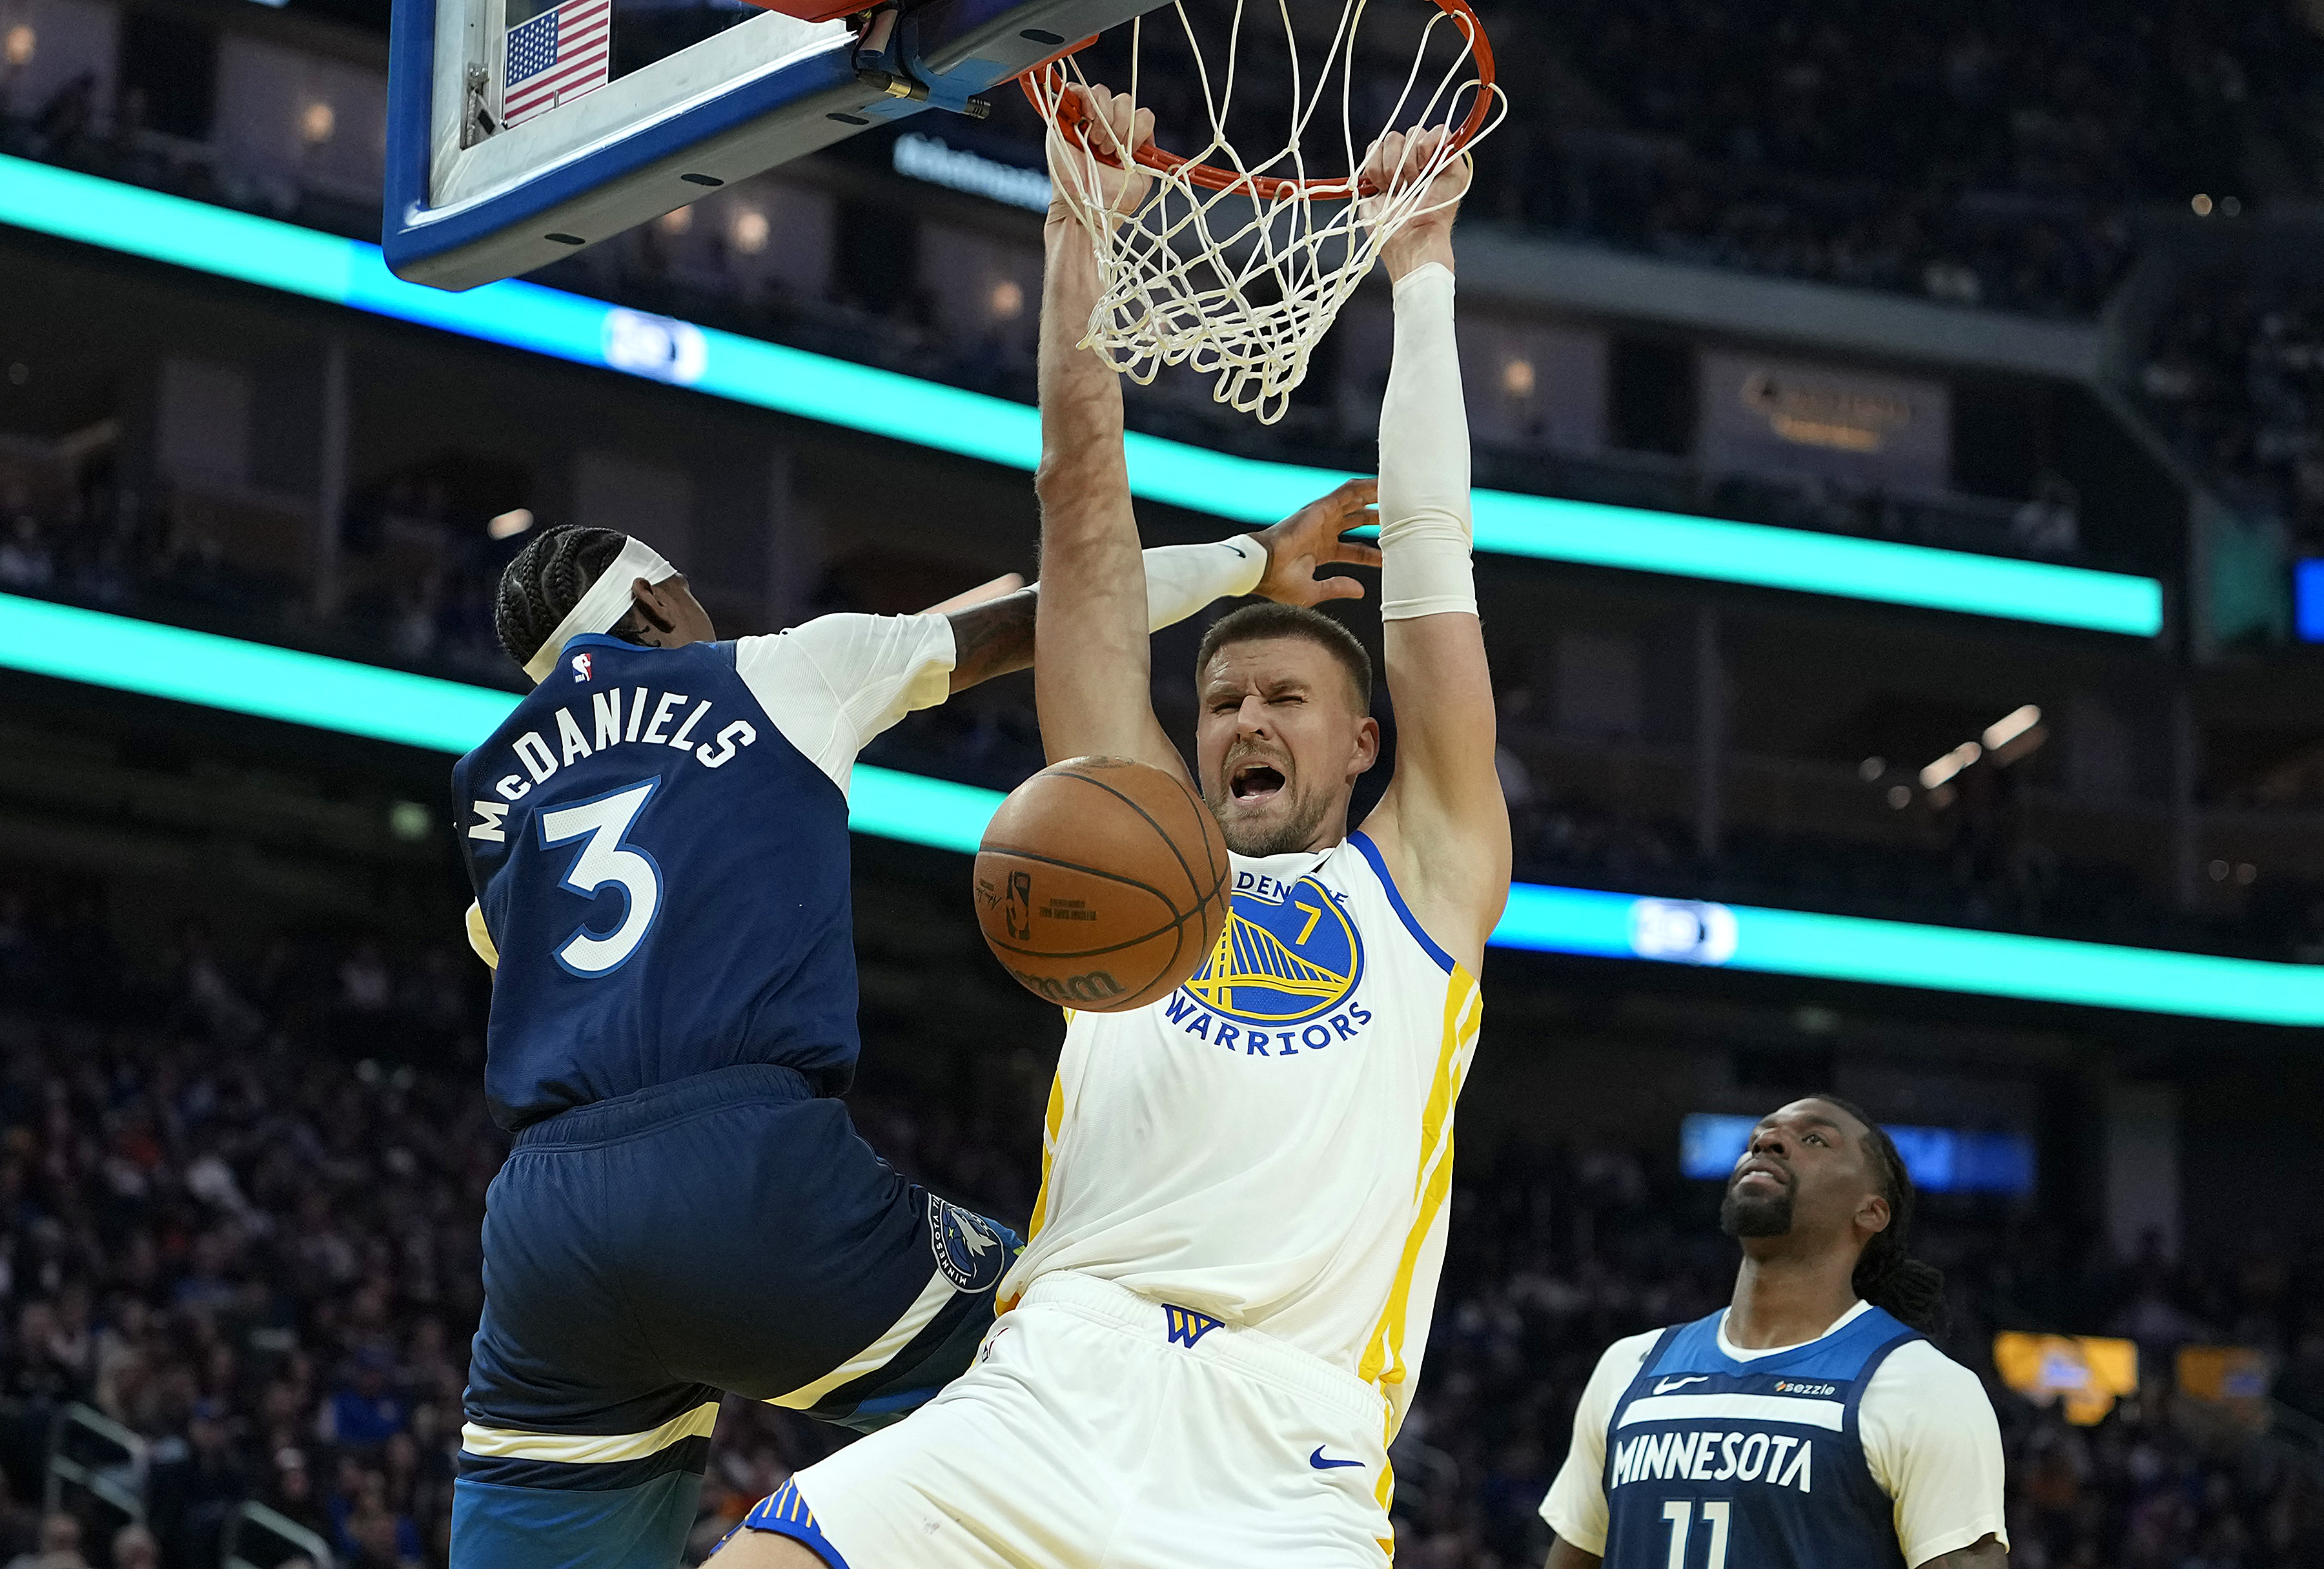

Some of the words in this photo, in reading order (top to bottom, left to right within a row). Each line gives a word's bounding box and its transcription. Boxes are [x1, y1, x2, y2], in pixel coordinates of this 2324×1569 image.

[535, 775, 664, 979] 3
[1236, 871, 1291, 899] DEN
[1294, 900, 1322, 945] 7
[1165, 989, 1372, 1057] WARRIORS
[932, 1215, 970, 1287] MINNESOTA
[1784, 1382, 1836, 1396] sezzle
[1611, 1431, 1812, 1493] MINNESOTA
[1662, 1499, 1731, 1569] 11
